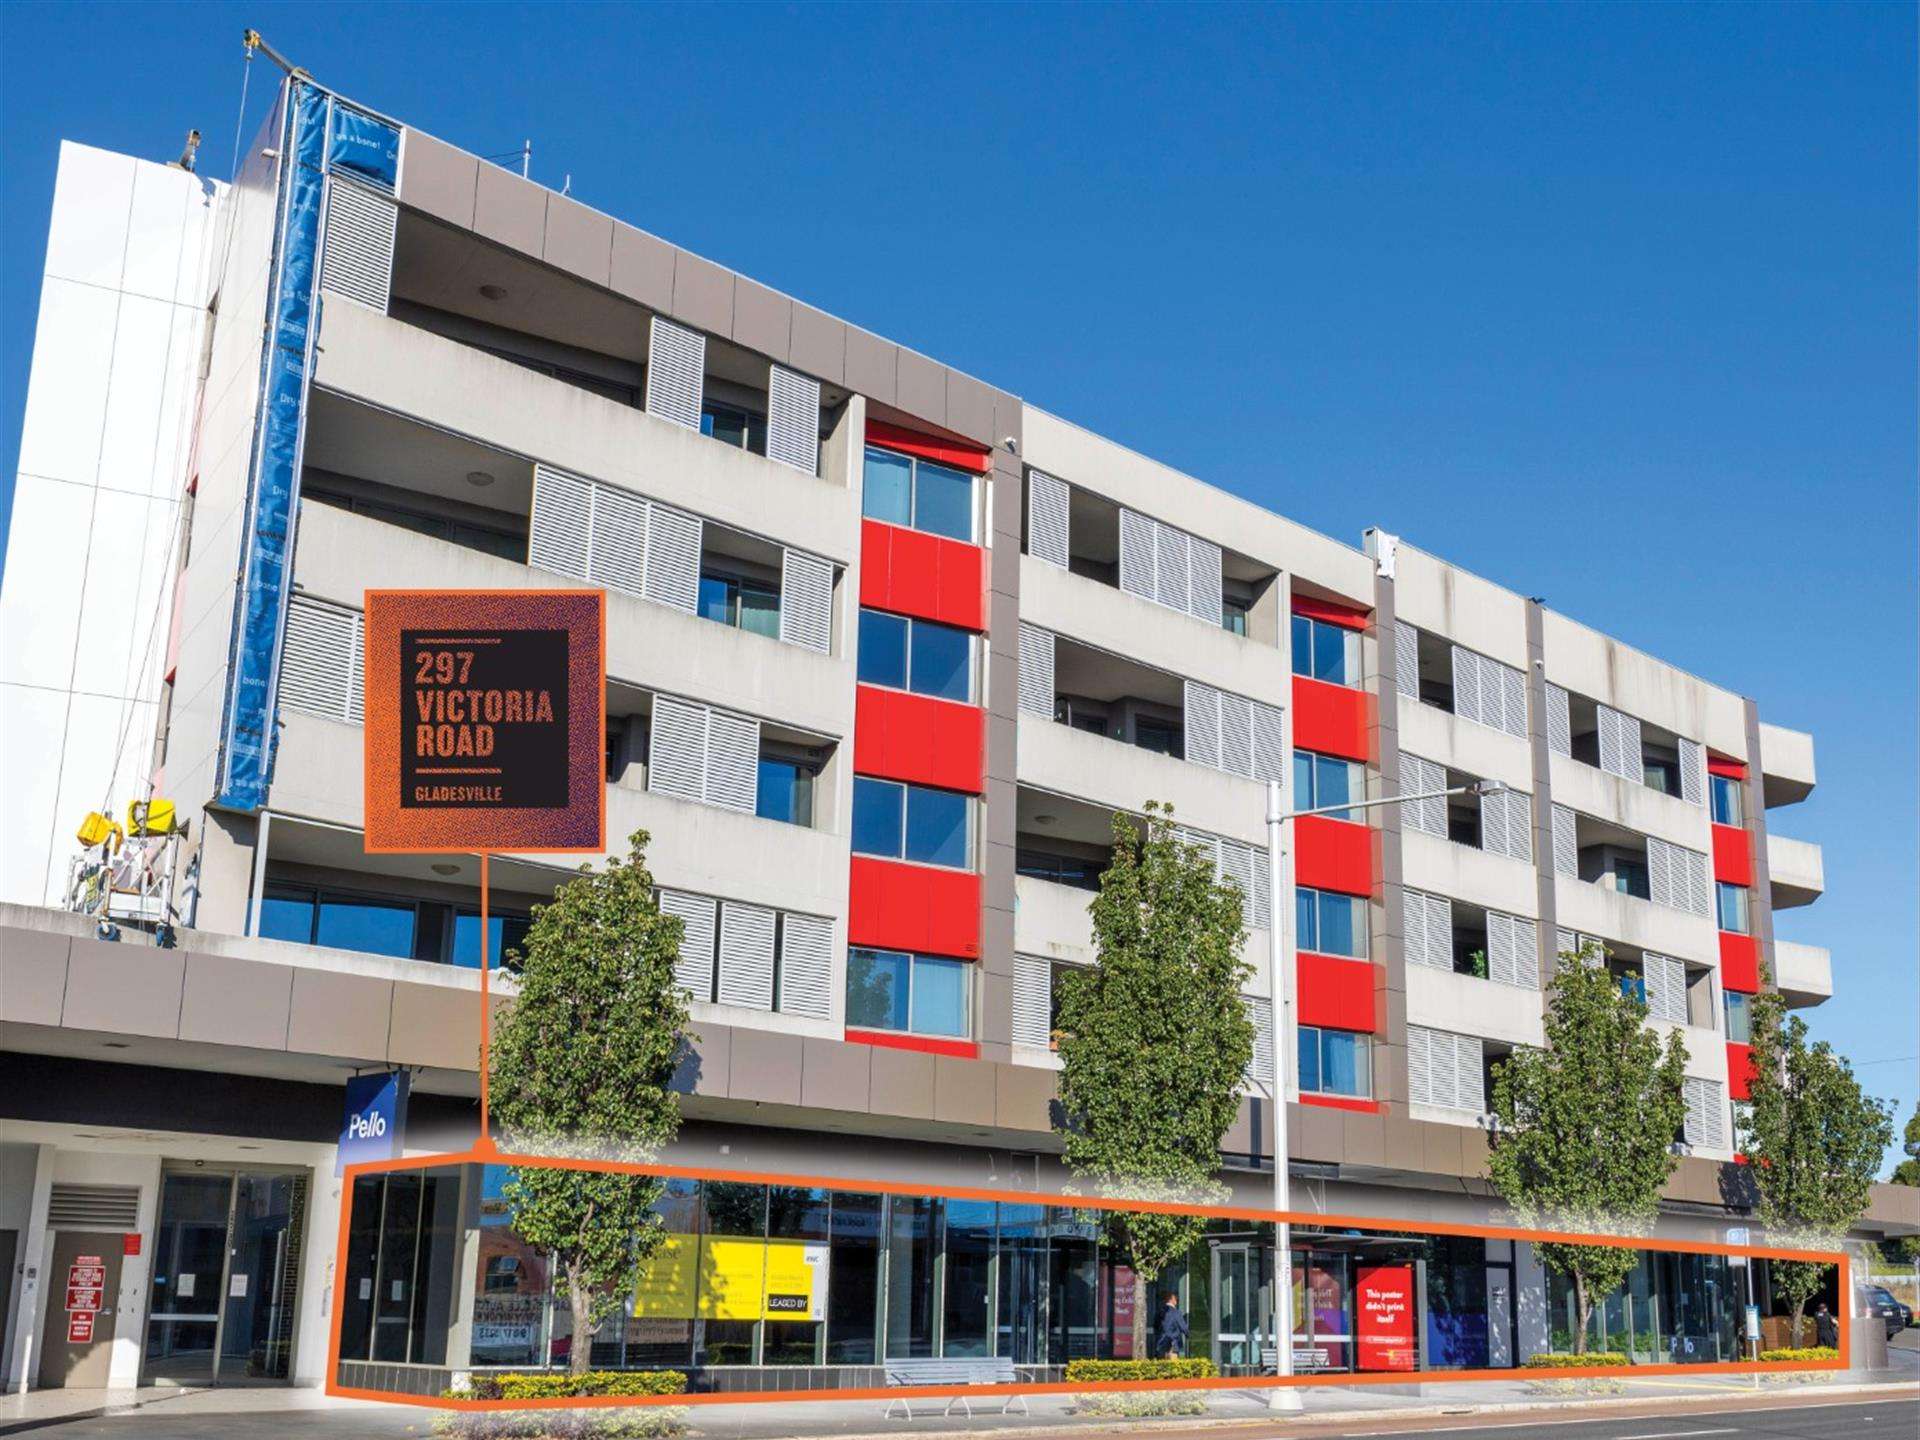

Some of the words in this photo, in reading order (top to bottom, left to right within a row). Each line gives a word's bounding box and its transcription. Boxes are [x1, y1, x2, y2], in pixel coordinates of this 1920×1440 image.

[272, 485, 288, 499] Dry
[349, 1111, 386, 1139] Pello
[1366, 1289, 1380, 1299] This
[1381, 1292, 1403, 1300] poster
[797, 1298, 807, 1309] BY
[1365, 1300, 1386, 1311] didn't
[1387, 1301, 1405, 1313] print
